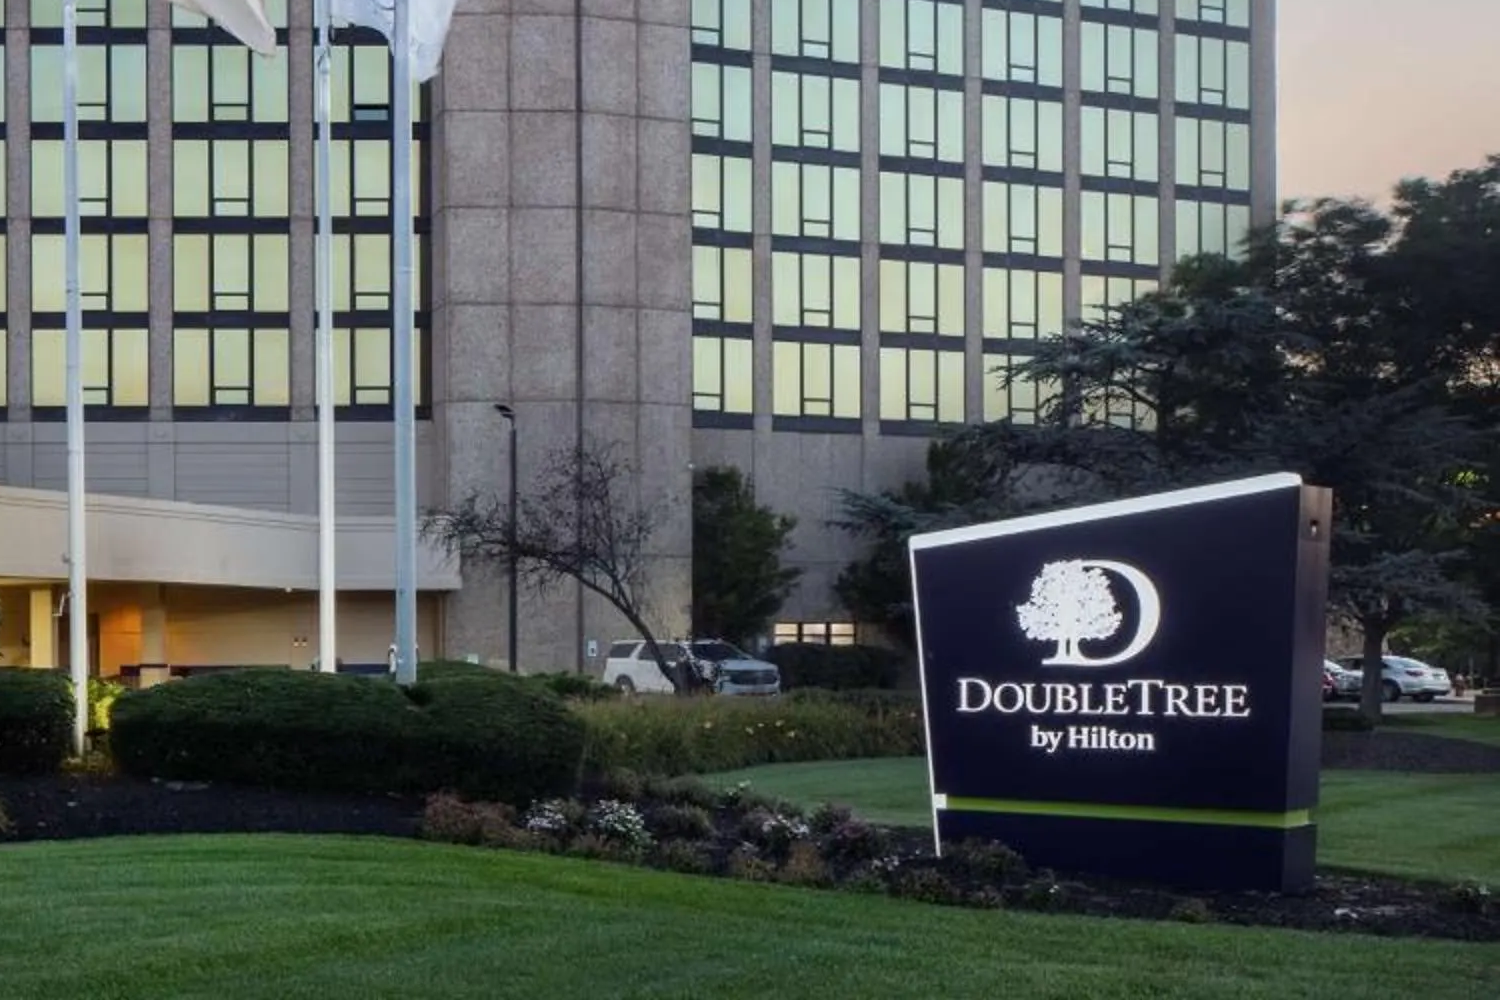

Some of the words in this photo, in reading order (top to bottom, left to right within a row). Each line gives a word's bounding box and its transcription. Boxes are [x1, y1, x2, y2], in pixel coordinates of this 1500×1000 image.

[956, 678, 1251, 717] DOUBLETREE
[1031, 725, 1064, 752] by
[1068, 727, 1155, 751] Hilton
